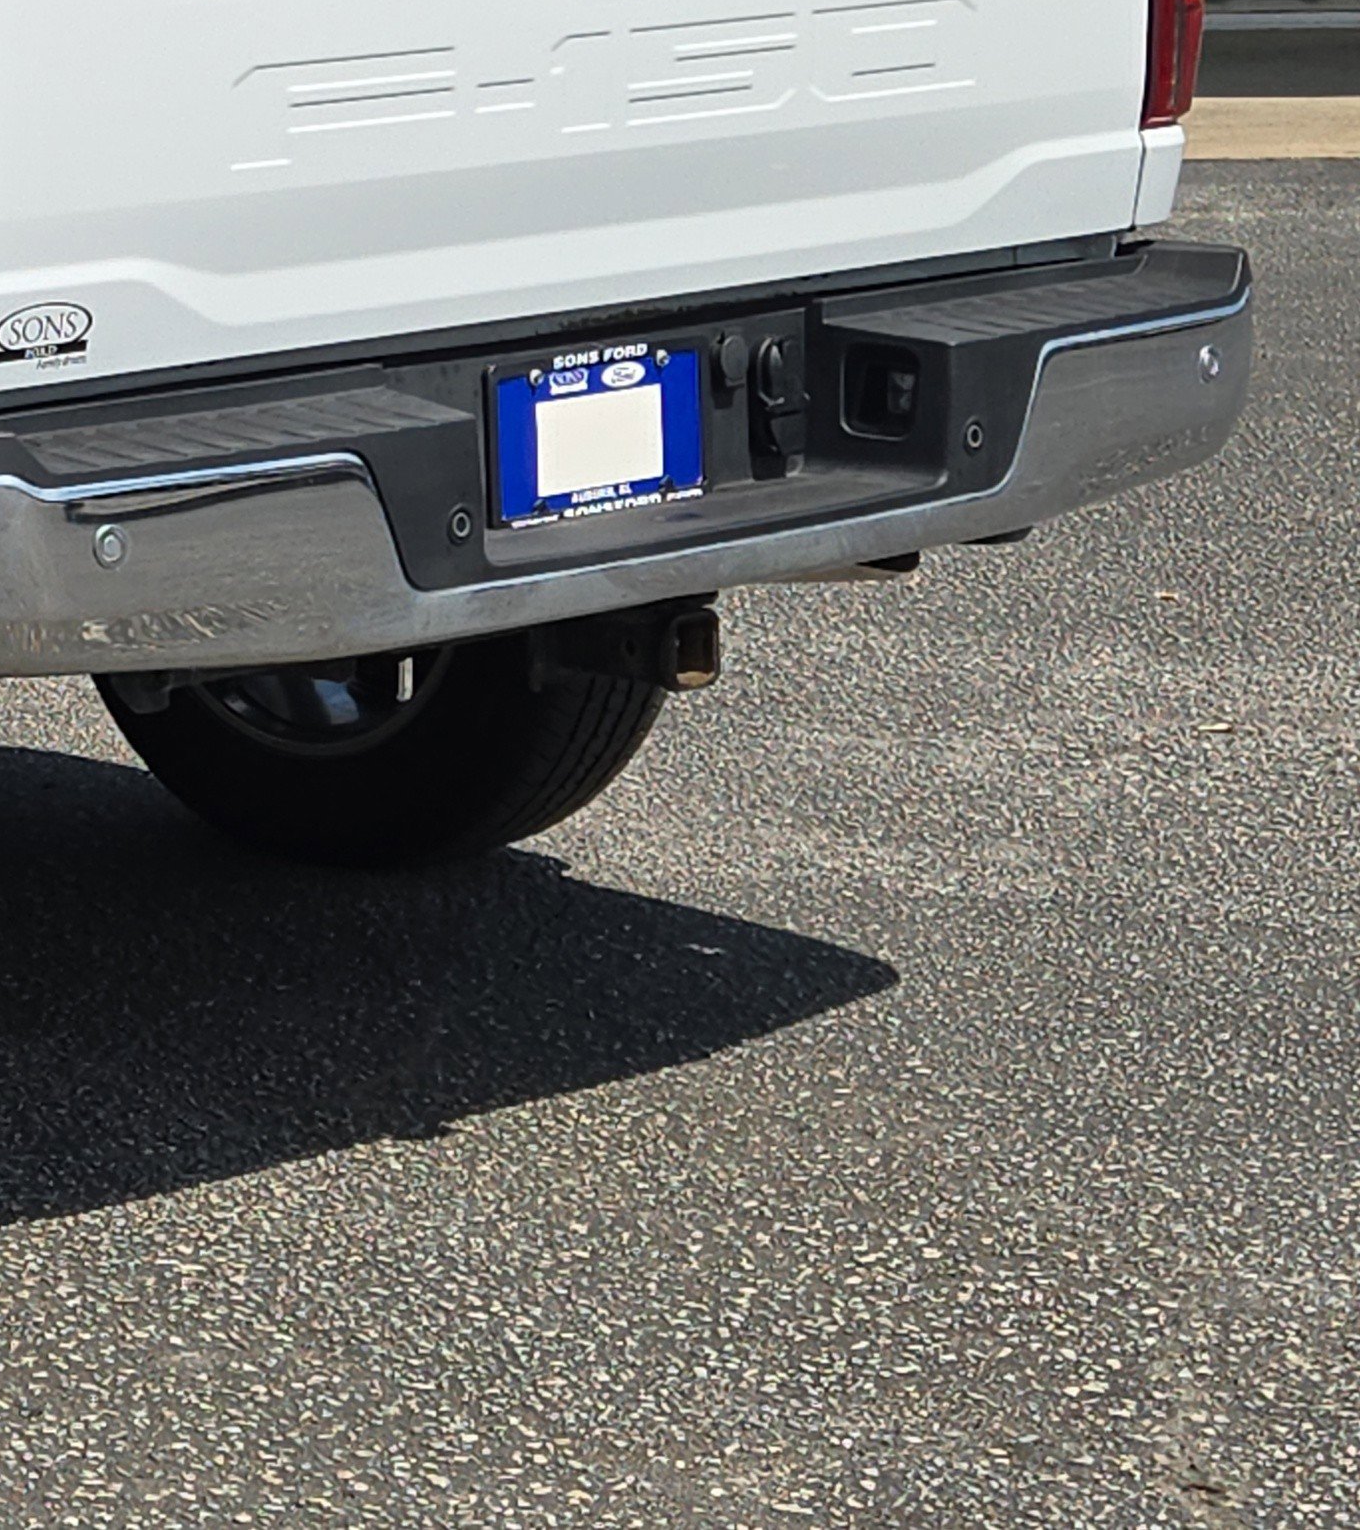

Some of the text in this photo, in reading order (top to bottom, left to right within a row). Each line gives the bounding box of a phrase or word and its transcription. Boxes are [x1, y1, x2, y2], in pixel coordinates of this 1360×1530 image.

[7, 310, 79, 346] SONS
[553, 343, 648, 370] SONS FORD
